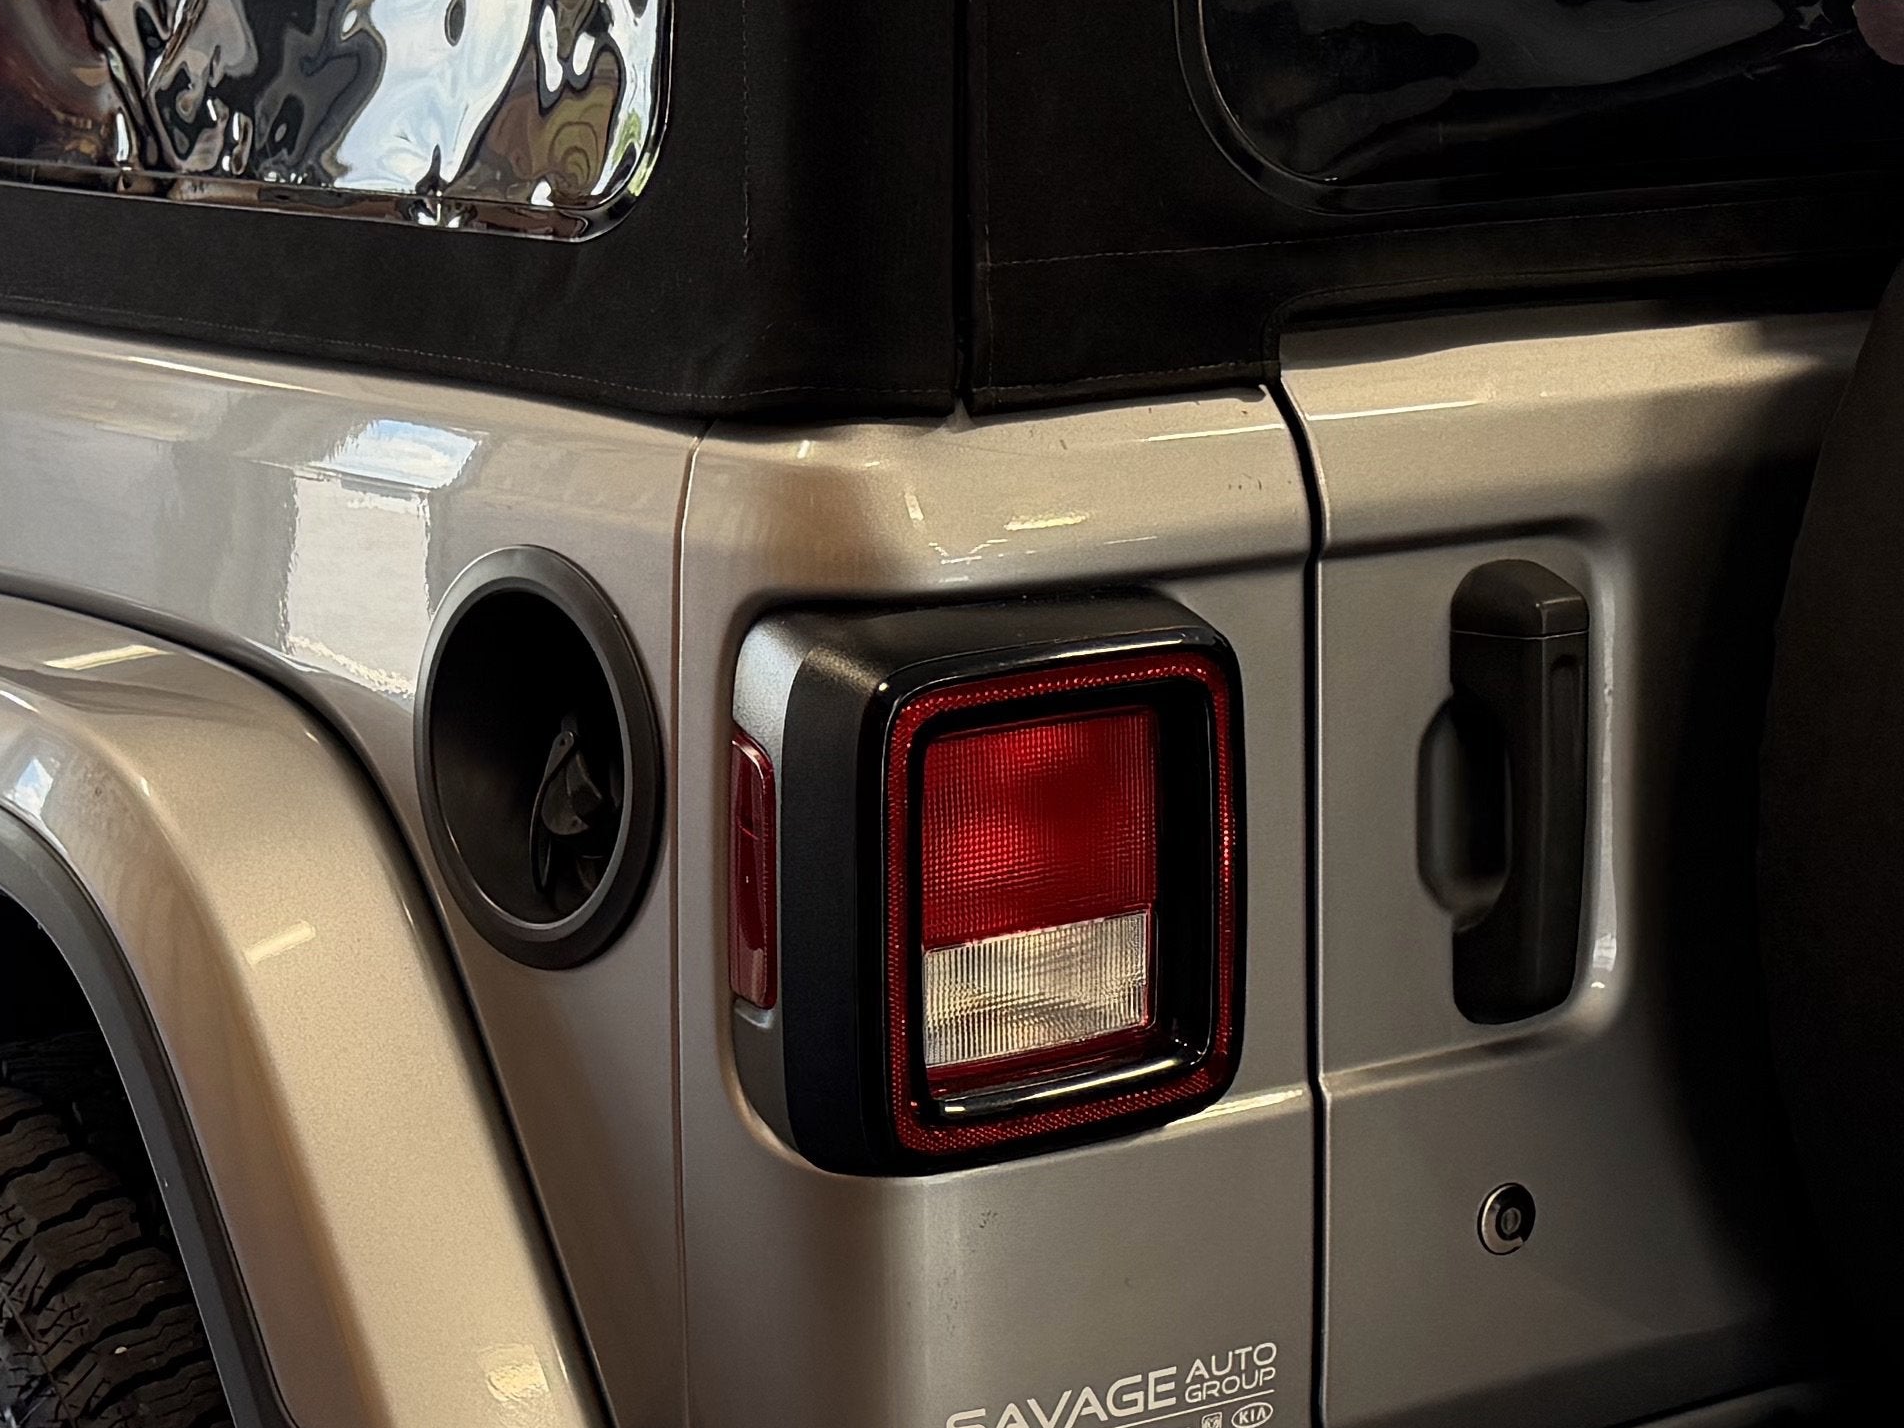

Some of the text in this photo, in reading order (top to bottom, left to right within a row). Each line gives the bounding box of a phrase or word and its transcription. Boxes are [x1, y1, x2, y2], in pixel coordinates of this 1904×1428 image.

[1185, 1342, 1277, 1384] AUTO
[1185, 1367, 1276, 1403] GROUP
[1237, 1405, 1269, 1425] KIA
